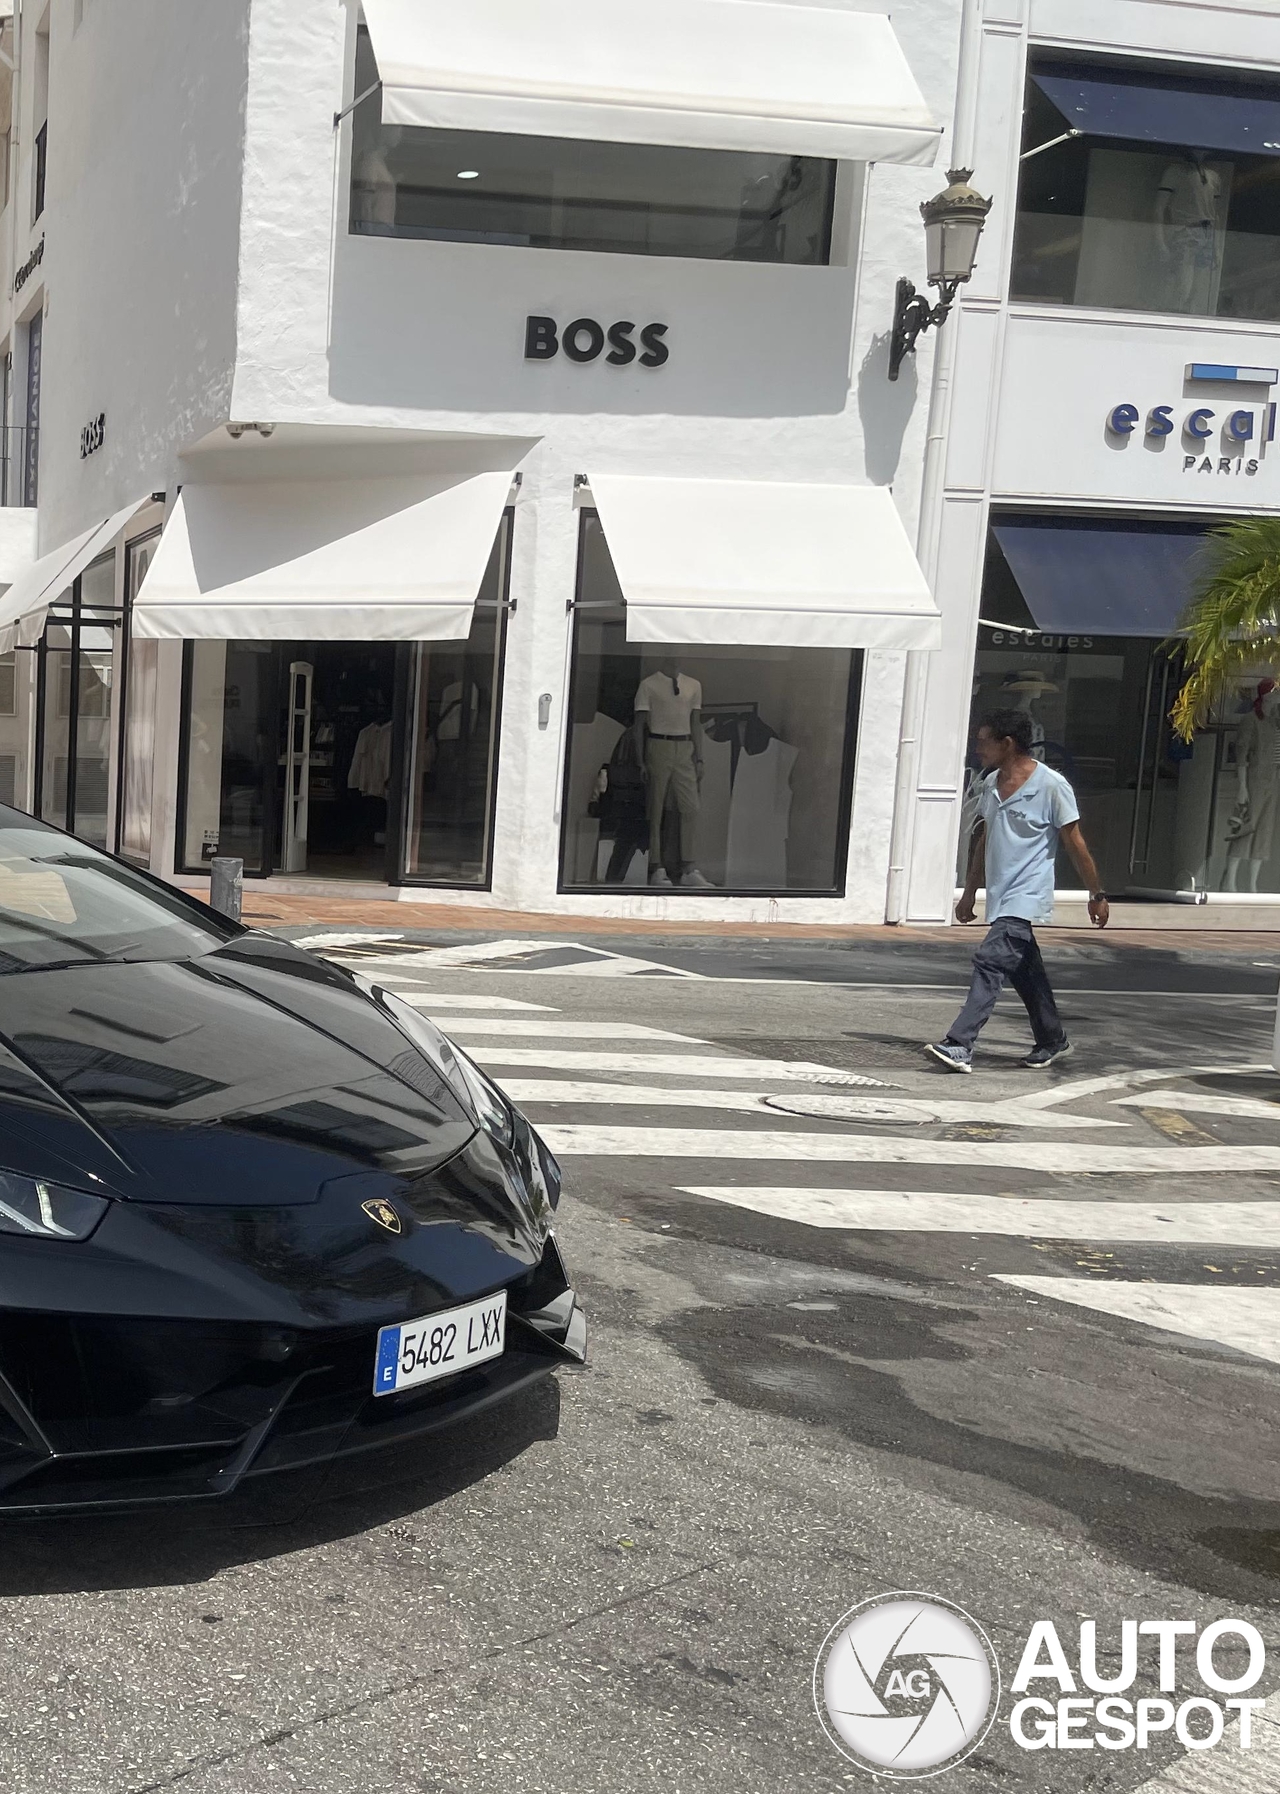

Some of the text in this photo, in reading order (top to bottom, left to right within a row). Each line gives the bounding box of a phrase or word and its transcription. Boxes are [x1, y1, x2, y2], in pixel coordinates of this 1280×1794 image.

[524, 316, 669, 367] BOSS
[80, 412, 106, 460] BOSS
[1183, 455, 1259, 475] PARIS
[402, 1305, 502, 1374] 5482 LXX
[383, 1366, 393, 1382] E
